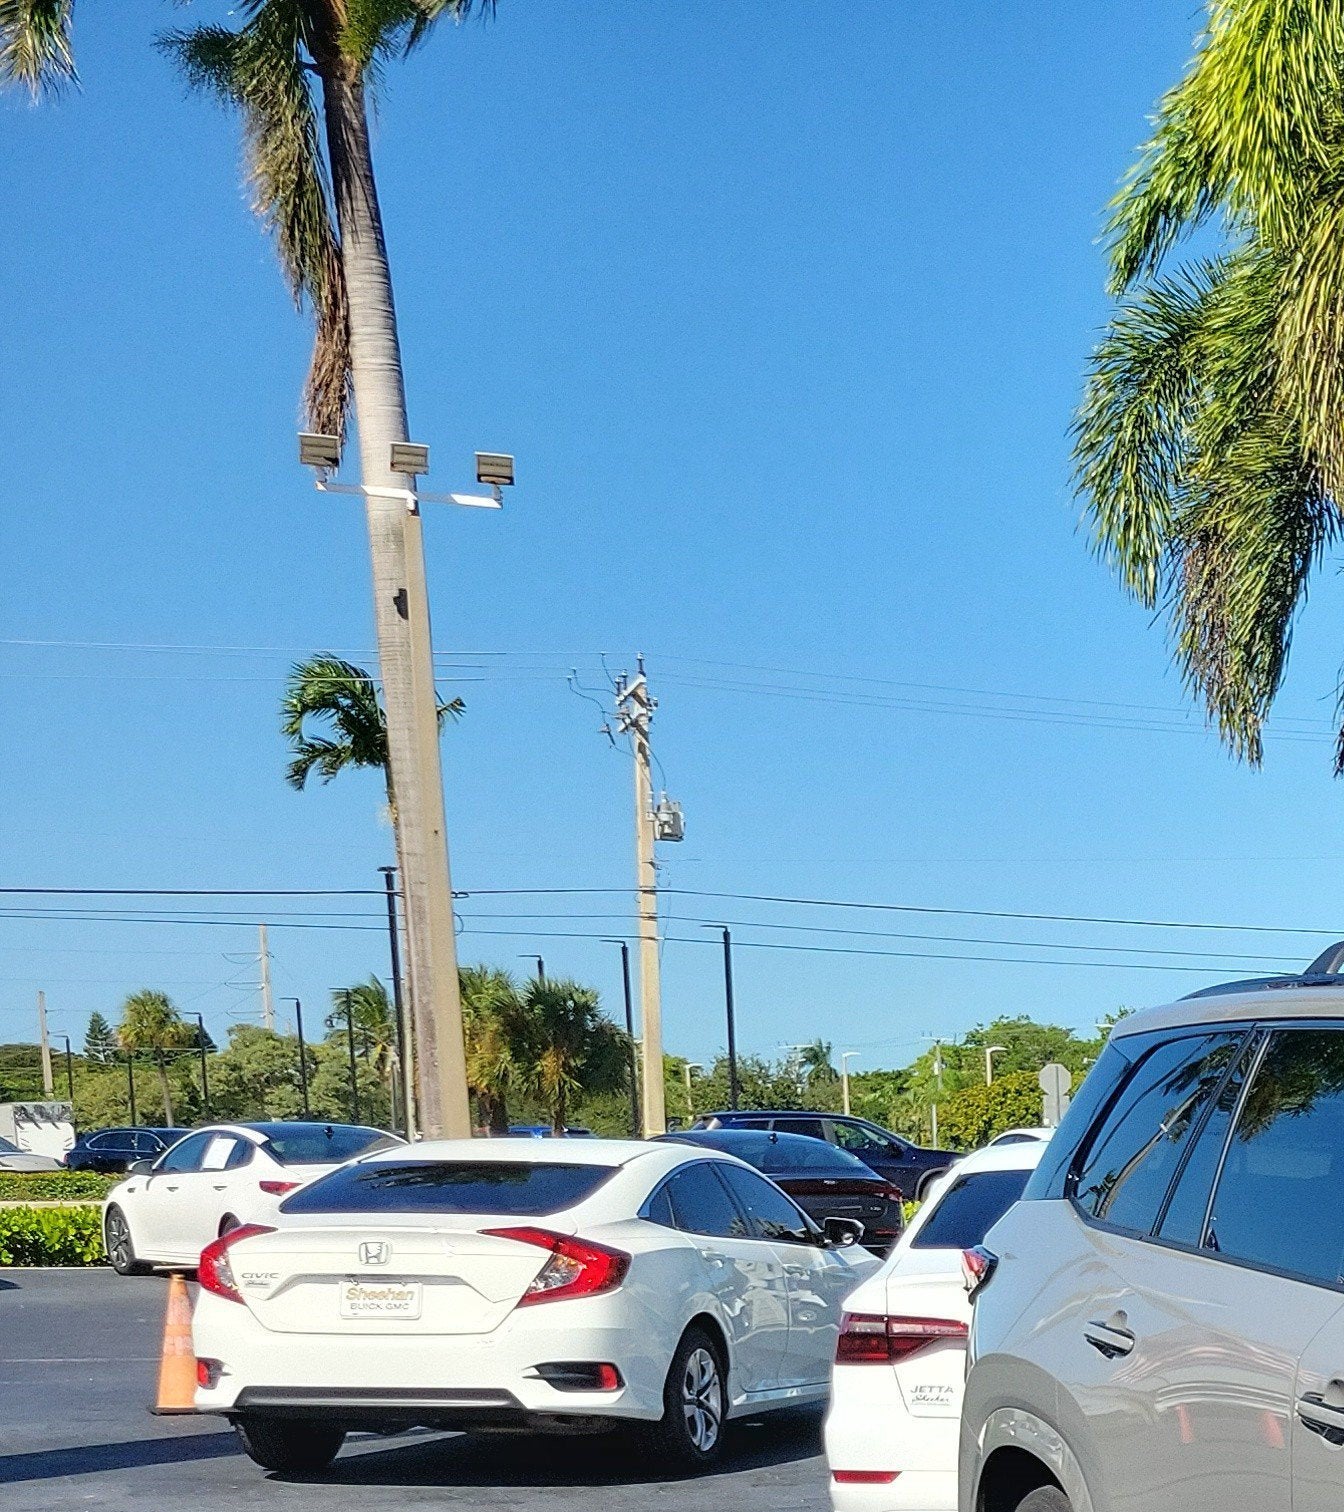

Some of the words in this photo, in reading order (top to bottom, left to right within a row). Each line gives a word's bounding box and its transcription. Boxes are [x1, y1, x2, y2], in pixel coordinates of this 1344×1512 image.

[346, 1287, 415, 1300] Sheehan
[350, 1302, 382, 1310] BUICK
[385, 1302, 410, 1310] GMC
[910, 1385, 954, 1394] JETTA
